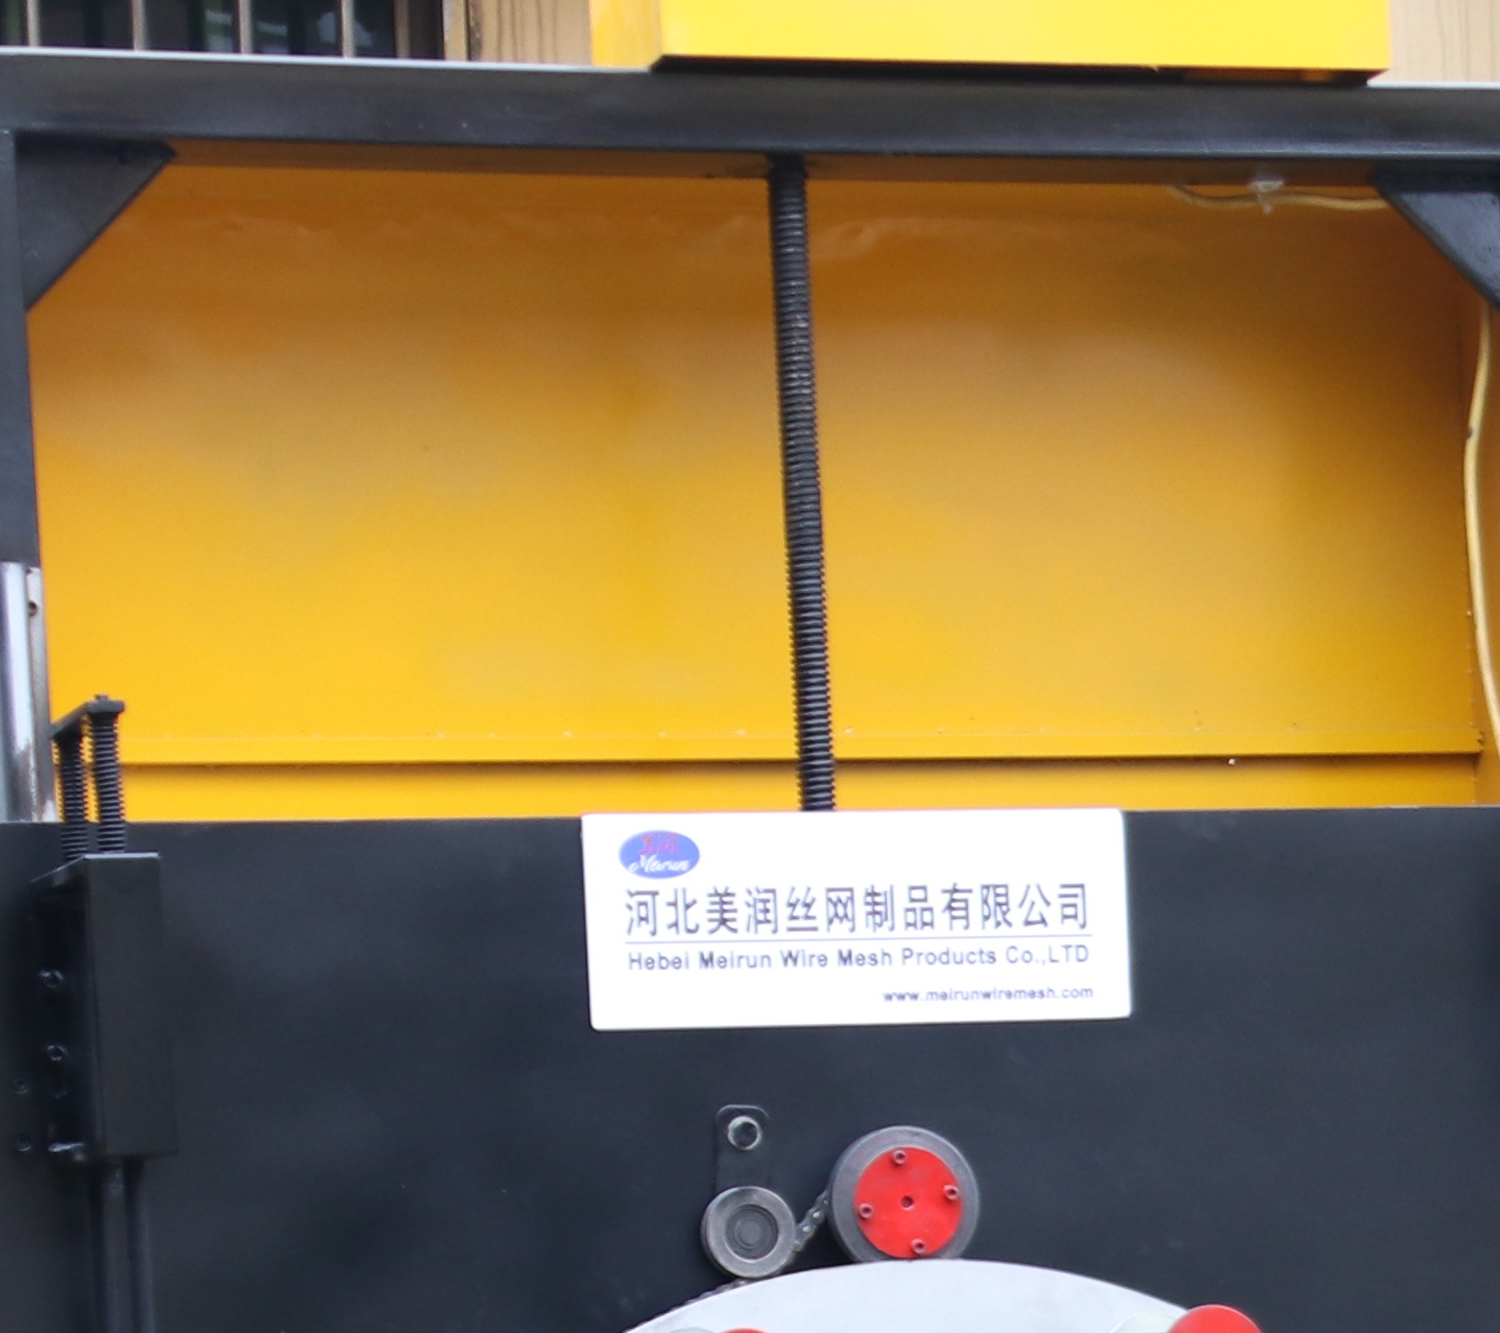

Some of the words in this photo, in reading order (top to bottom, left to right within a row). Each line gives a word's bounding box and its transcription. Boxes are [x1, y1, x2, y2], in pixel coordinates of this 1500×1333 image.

[625, 882, 1088, 937] 河北美润丝网制品有限公司
[628, 951, 690, 971] Hebei
[699, 949, 772, 970] Meirun
[780, 949, 828, 968] Wire
[837, 948, 893, 968] Mesh
[901, 947, 997, 967] Products
[882, 986, 1094, 1003] www.meirunwiremesh.com
